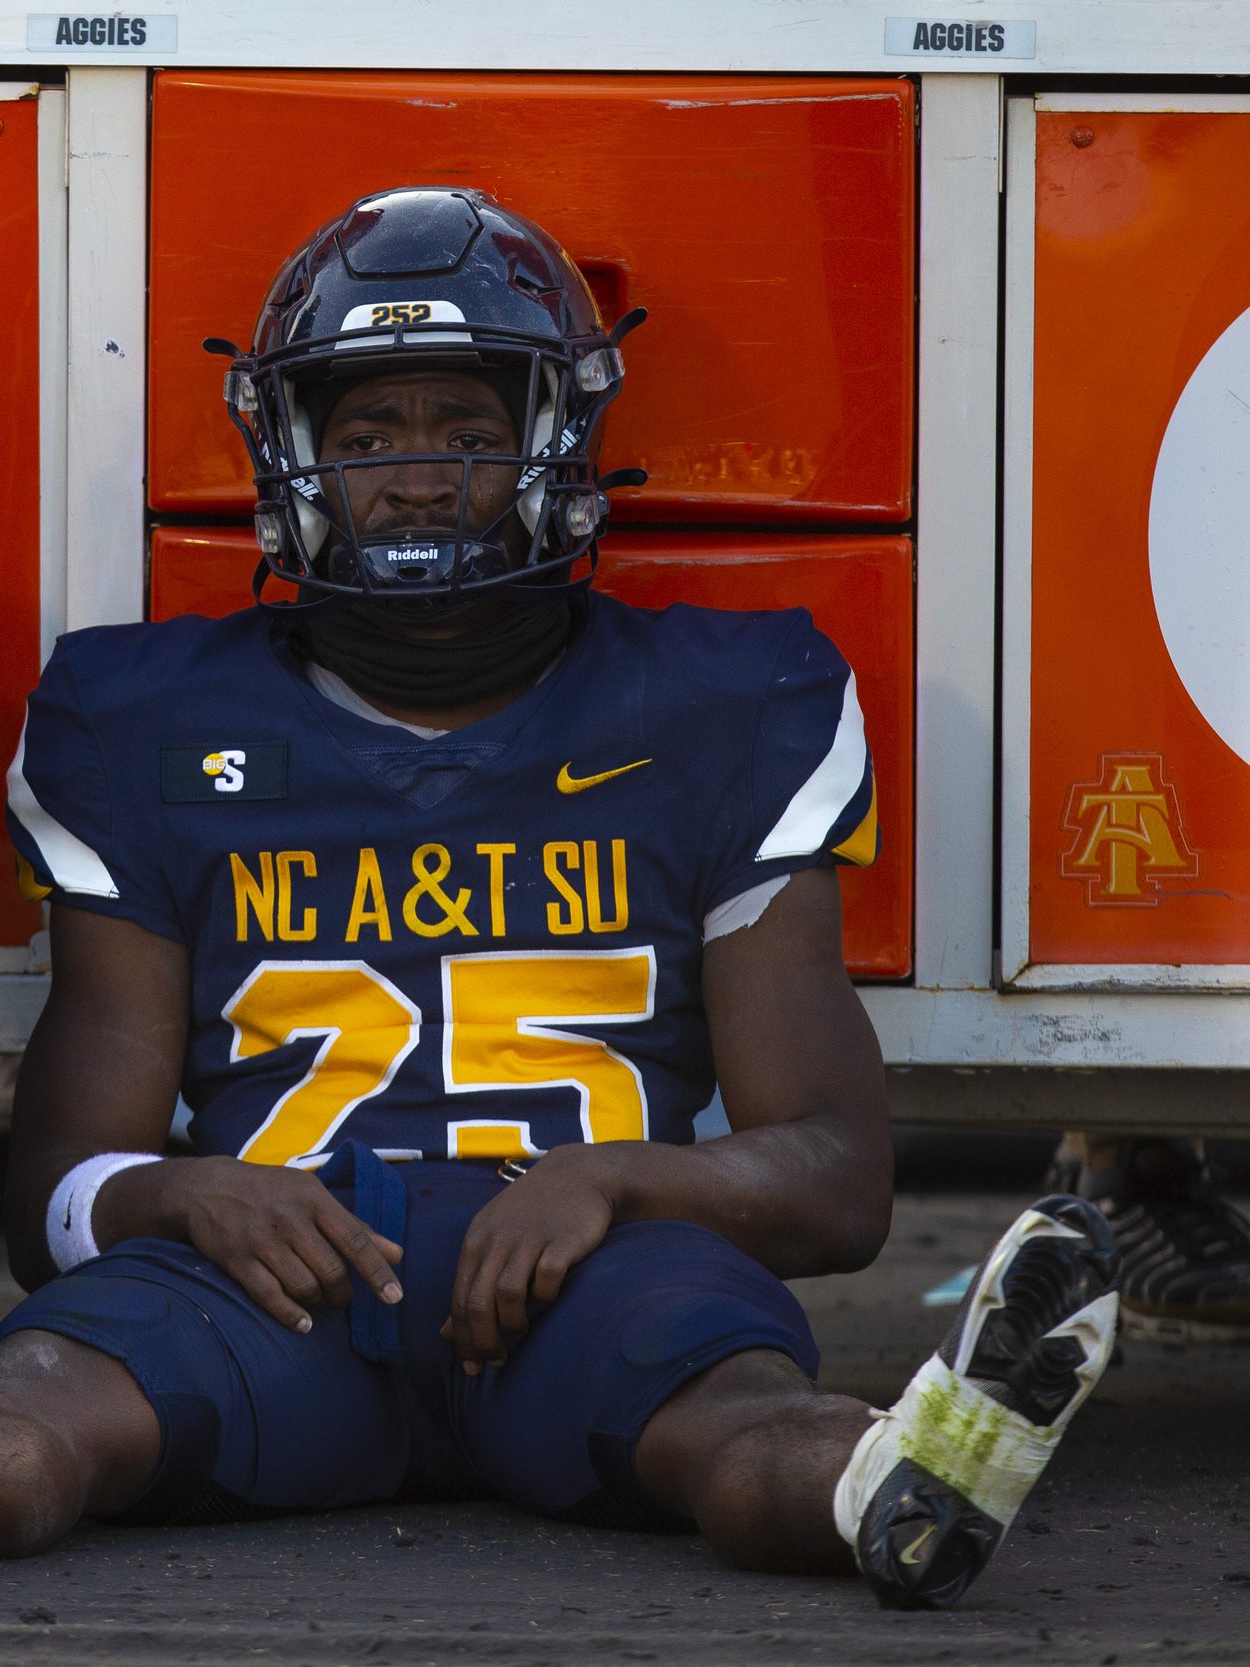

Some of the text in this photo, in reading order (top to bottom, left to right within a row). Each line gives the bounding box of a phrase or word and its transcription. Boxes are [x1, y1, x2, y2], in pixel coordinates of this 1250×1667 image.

[55, 17, 147, 46] AGGIES
[913, 22, 1005, 52] AGGIES
[371, 303, 432, 327] 252
[387, 548, 439, 561] Riddell
[230, 839, 629, 942] NC A&T SU
[221, 945, 658, 1171] 25
